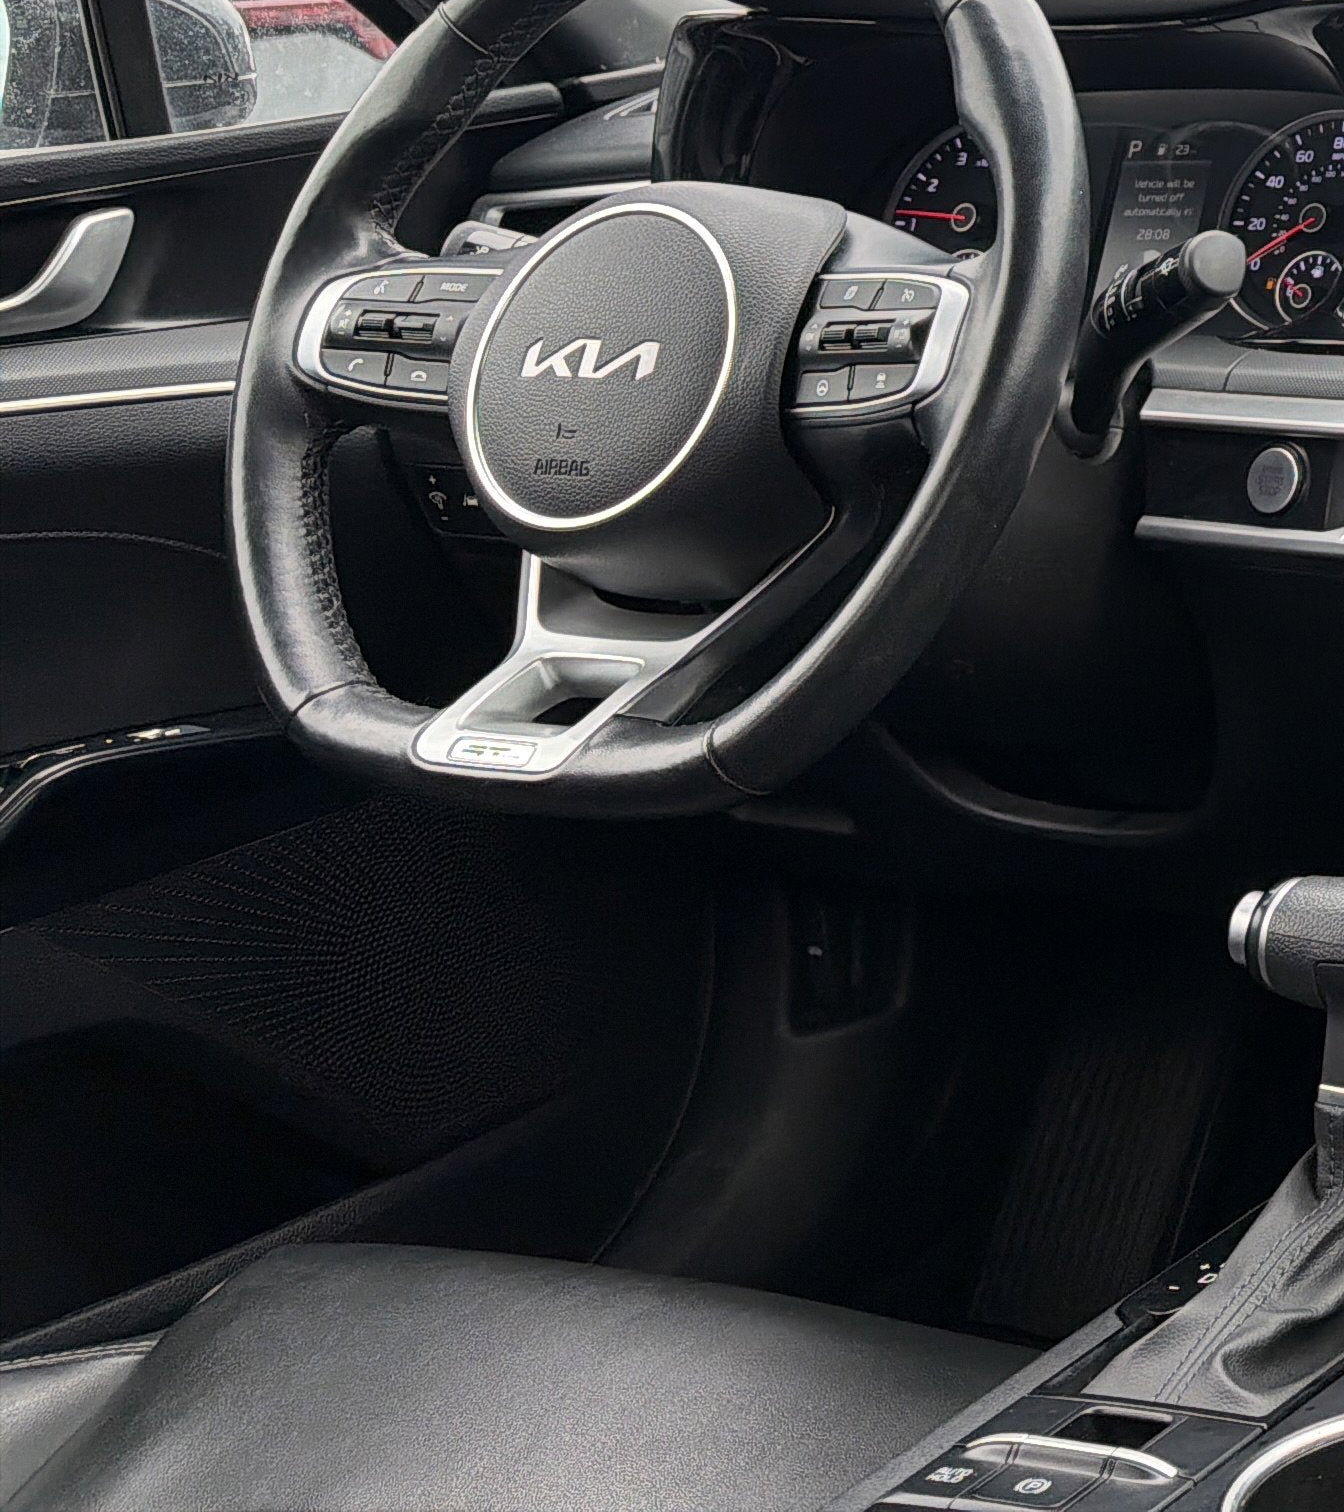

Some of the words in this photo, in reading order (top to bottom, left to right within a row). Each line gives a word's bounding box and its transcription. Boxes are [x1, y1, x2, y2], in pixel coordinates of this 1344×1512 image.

[1128, 140, 1143, 159] P
[1175, 144, 1190, 156] 23
[956, 152, 968, 166] 3
[1295, 150, 1315, 163] 60
[927, 178, 939, 192] 2
[1135, 180, 1164, 188] Vehicle
[1184, 180, 1195, 188] be
[1265, 176, 1285, 188] 40
[1139, 193, 1166, 202] turned
[1169, 192, 1185, 202] off
[1124, 208, 1181, 217] automatically
[1247, 217, 1266, 230] 20
[1136, 229, 1171, 240] 28:08
[440, 282, 468, 292] MODE
[520, 338, 661, 380] KIA
[533, 458, 590, 477] AIRBAG
[935, 1466, 974, 1476] AUTO
